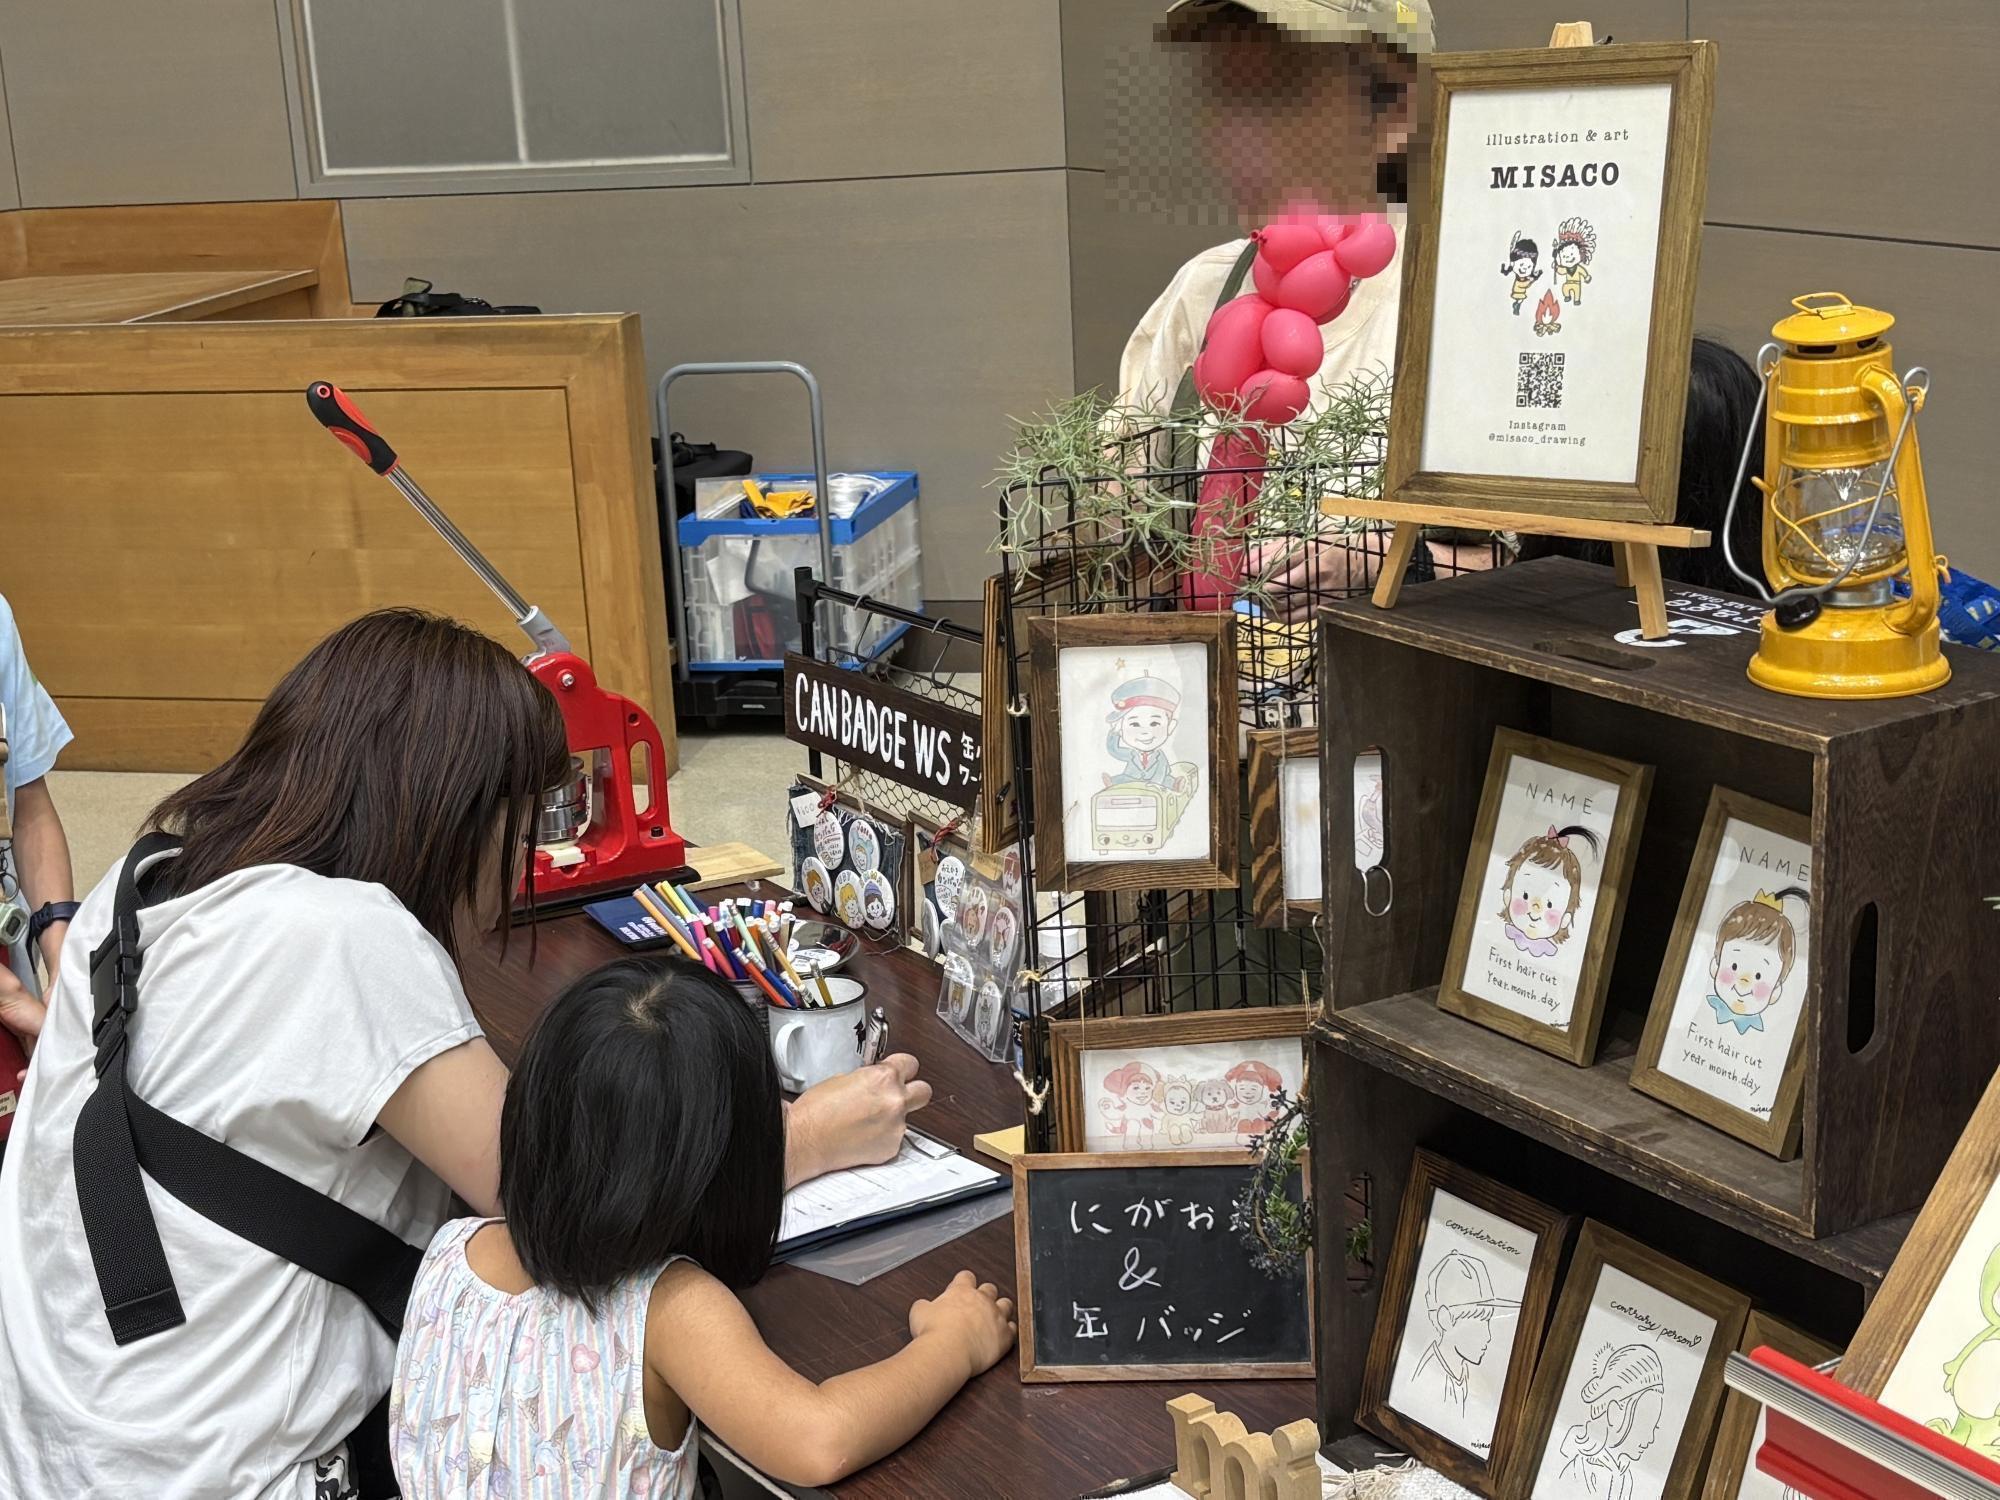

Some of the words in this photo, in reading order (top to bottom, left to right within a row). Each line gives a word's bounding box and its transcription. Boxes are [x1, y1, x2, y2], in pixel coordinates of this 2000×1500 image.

[1486, 131, 1578, 146] illustration
[1585, 129, 1597, 142] &
[1603, 129, 1629, 141] art
[1490, 162, 1619, 189] MISACO
[1488, 433, 1586, 447] @misaco_drawing
[1508, 420, 1566, 432] Instagram
[795, 672, 838, 741] CAN
[841, 688, 908, 770] BADGE
[912, 719, 952, 786] WS
[959, 764, 982, 792] ワー
[1526, 782, 1593, 815] NAME
[1740, 846, 1809, 881] NAME
[1489, 946, 1513, 970] First
[1516, 959, 1537, 979] hair
[1540, 972, 1558, 986] cut
[1687, 1021, 1714, 1049] First
[1718, 1037, 1740, 1060] hair
[1744, 1054, 1763, 1069] cut
[1445, 1219, 1521, 1255] consideration
[1118, 1246, 1162, 1290] &
[1610, 1301, 1662, 1332] contrary
[1656, 1327, 1696, 1348] person
